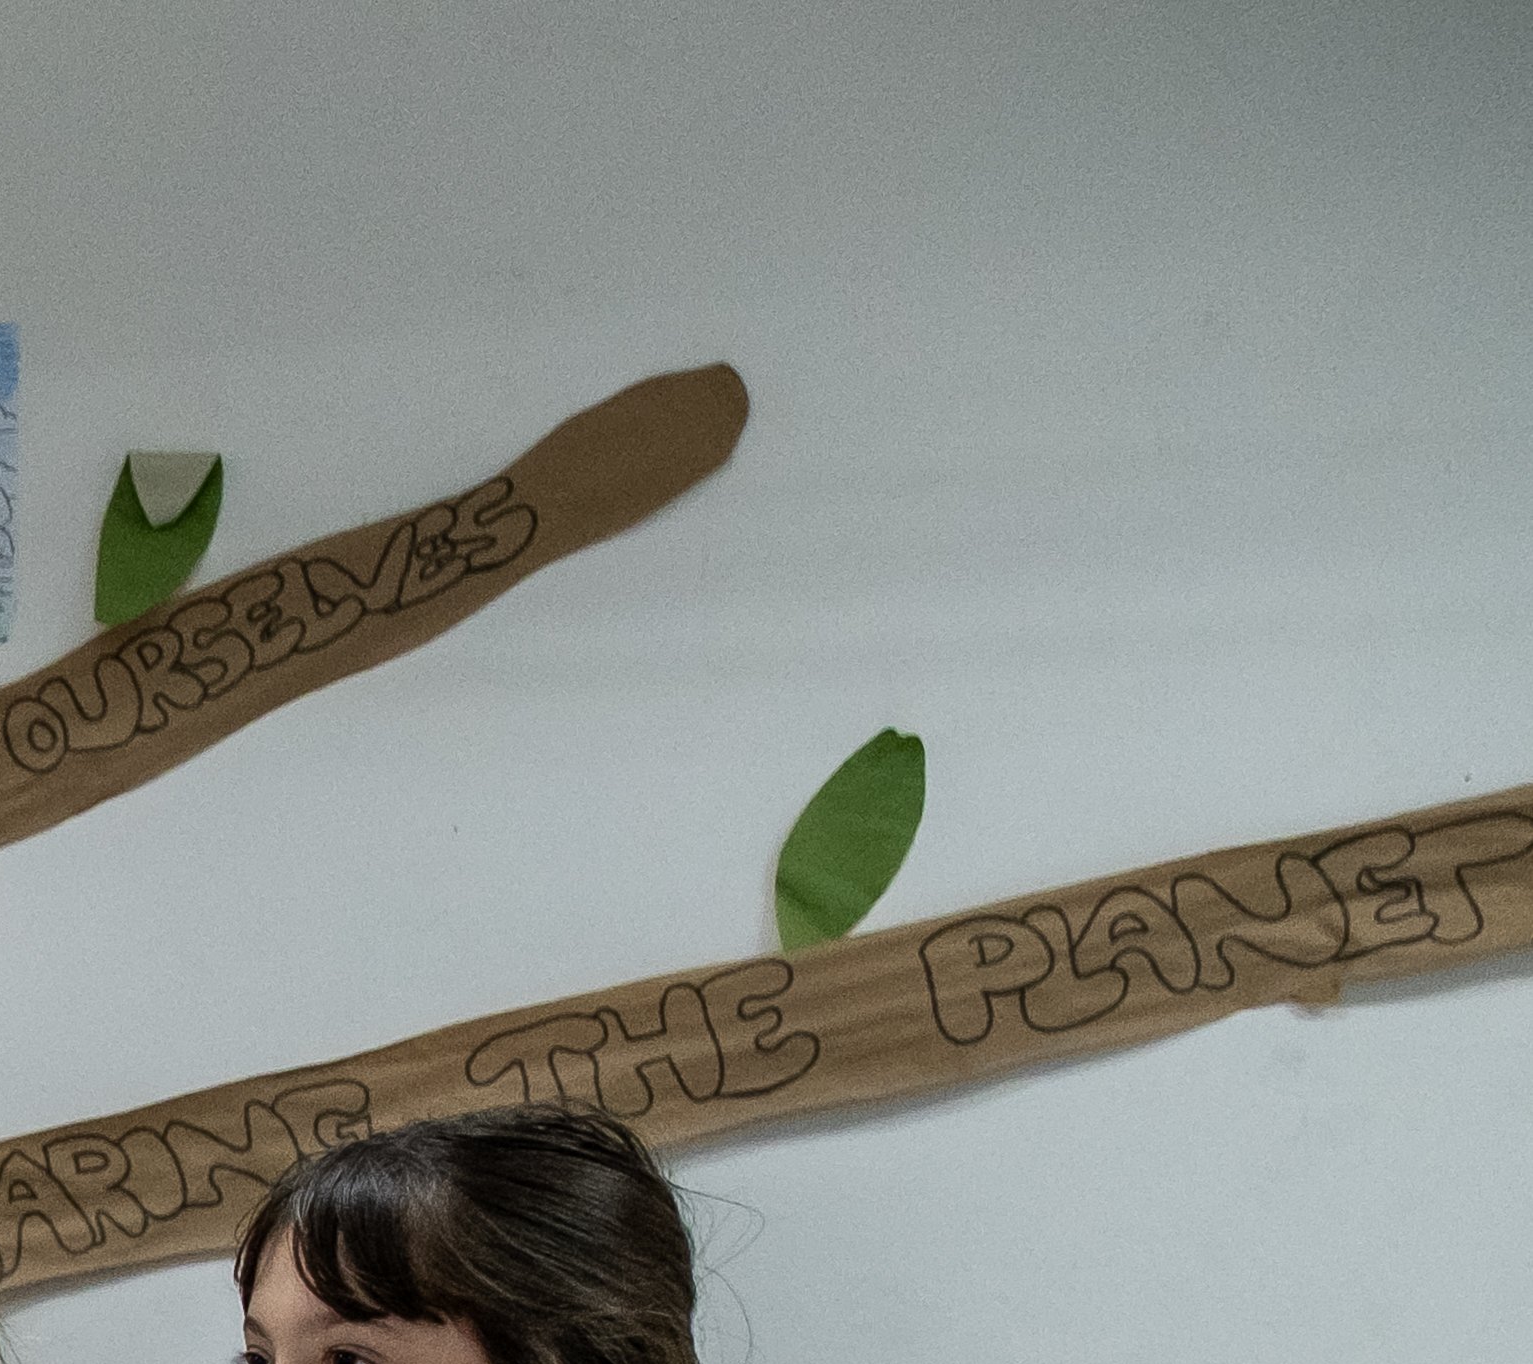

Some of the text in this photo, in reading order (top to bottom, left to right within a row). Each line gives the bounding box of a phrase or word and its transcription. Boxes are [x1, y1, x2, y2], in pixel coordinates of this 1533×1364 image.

[2, 475, 538, 775] OURSELVES
[465, 957, 822, 1118] THE
[920, 811, 1533, 1046] PLANET
